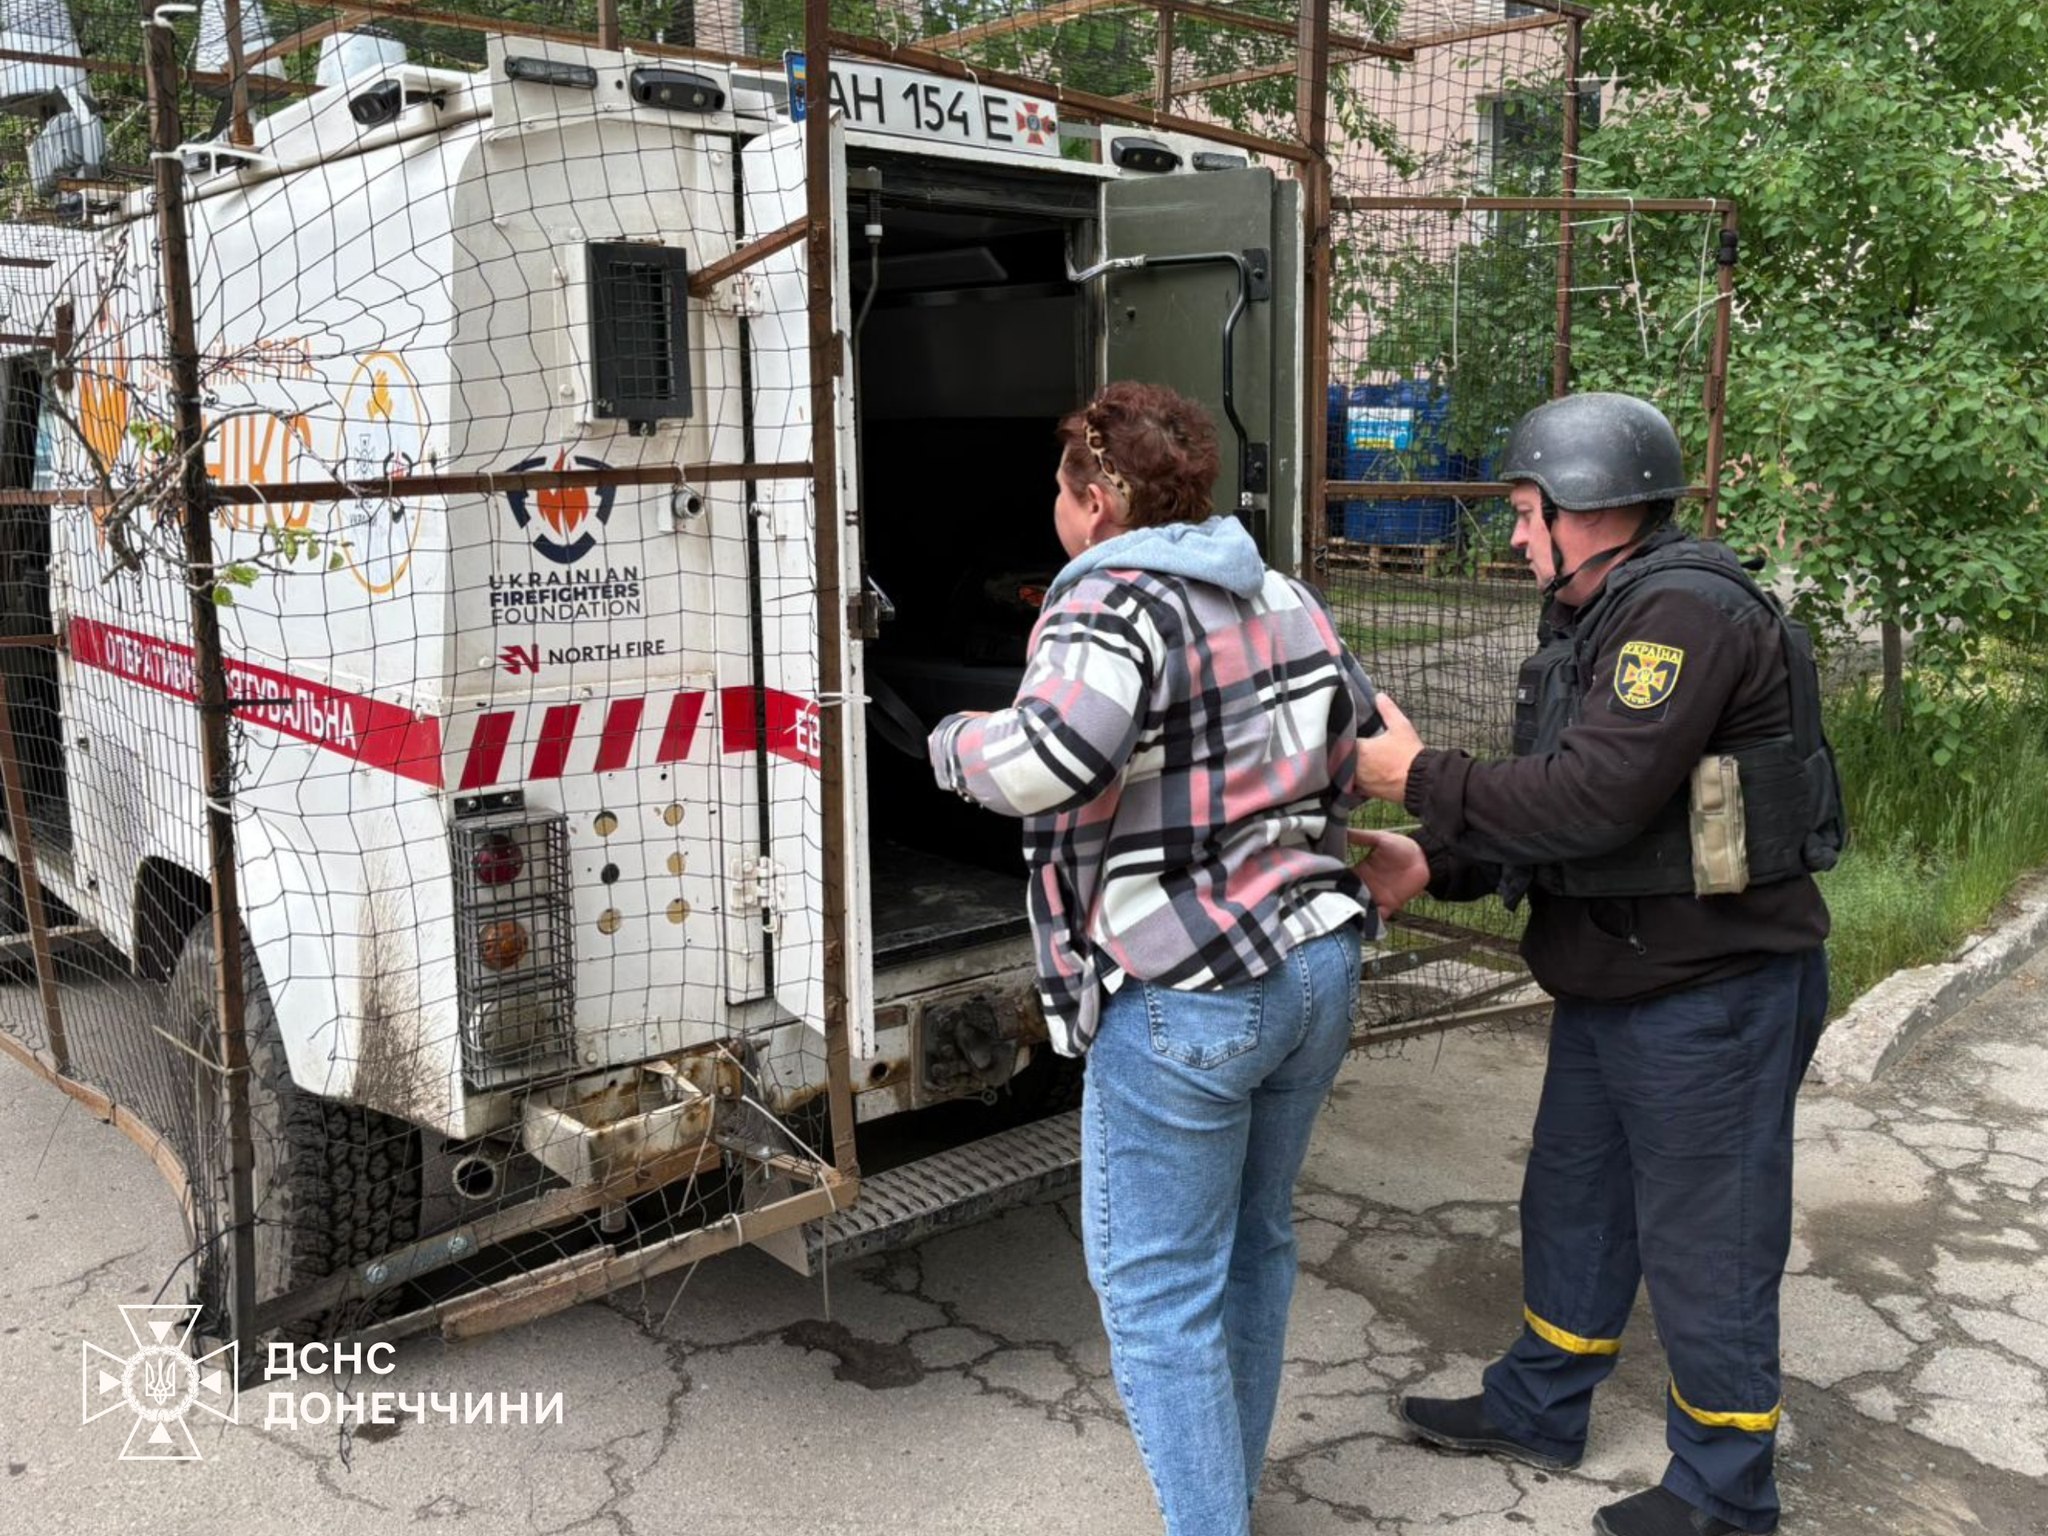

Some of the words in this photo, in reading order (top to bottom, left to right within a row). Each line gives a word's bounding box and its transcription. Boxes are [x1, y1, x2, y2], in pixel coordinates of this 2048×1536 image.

[902, 82, 969, 136] 154
[489, 566, 638, 590] UKRAINIAN
[490, 583, 640, 608] FIREFIGHTERS
[491, 599, 641, 626] FOUNDATION
[549, 642, 620, 665] NORTH
[626, 639, 665, 657] FIRE
[1624, 643, 1680, 663] УКРАЇНА
[105, 629, 198, 694] ОПЕРАТИВН
[224, 668, 357, 751] ЯТУВАЛЬНА
[795, 707, 821, 759] ЕВ
